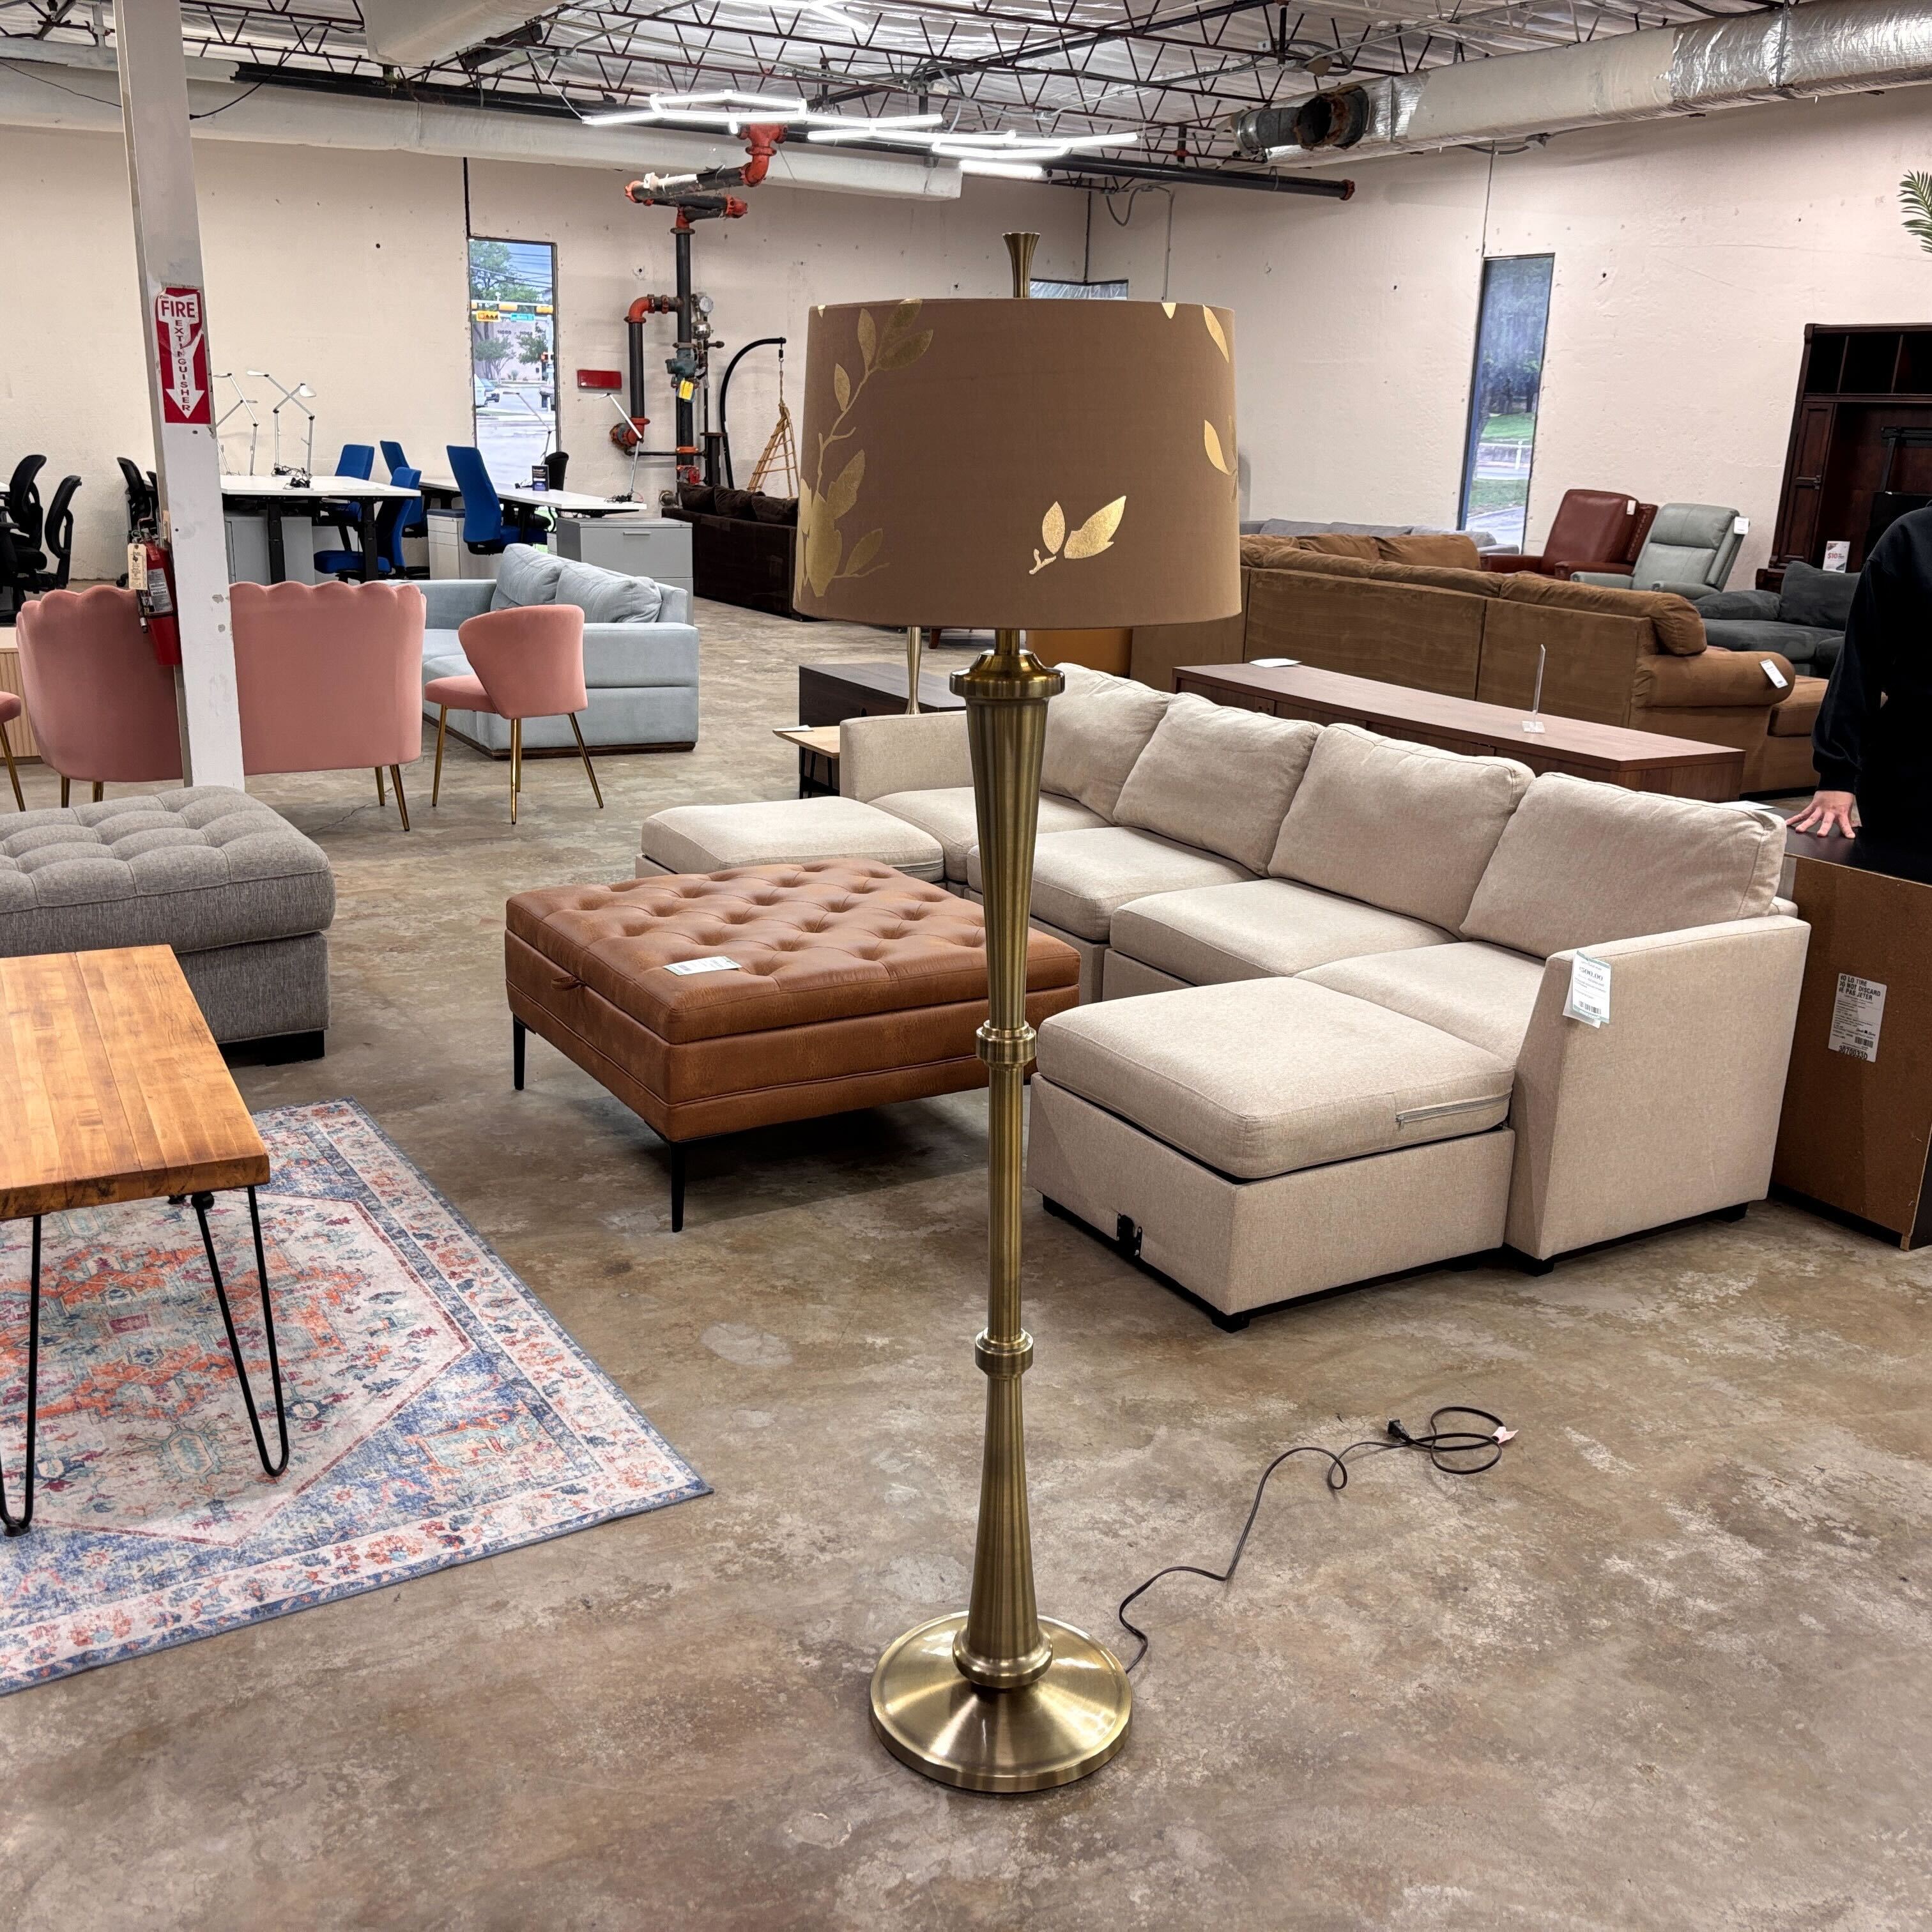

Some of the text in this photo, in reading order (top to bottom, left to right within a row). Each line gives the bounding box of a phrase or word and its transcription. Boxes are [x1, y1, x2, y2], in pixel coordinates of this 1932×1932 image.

[161, 300, 195, 318] FIRE
[174, 320, 191, 411] EXTINGUISHER
[1846, 988, 1856, 996] PAS
[1857, 992, 1873, 1001] JETER
[1858, 986, 1881, 997] DISCARD
